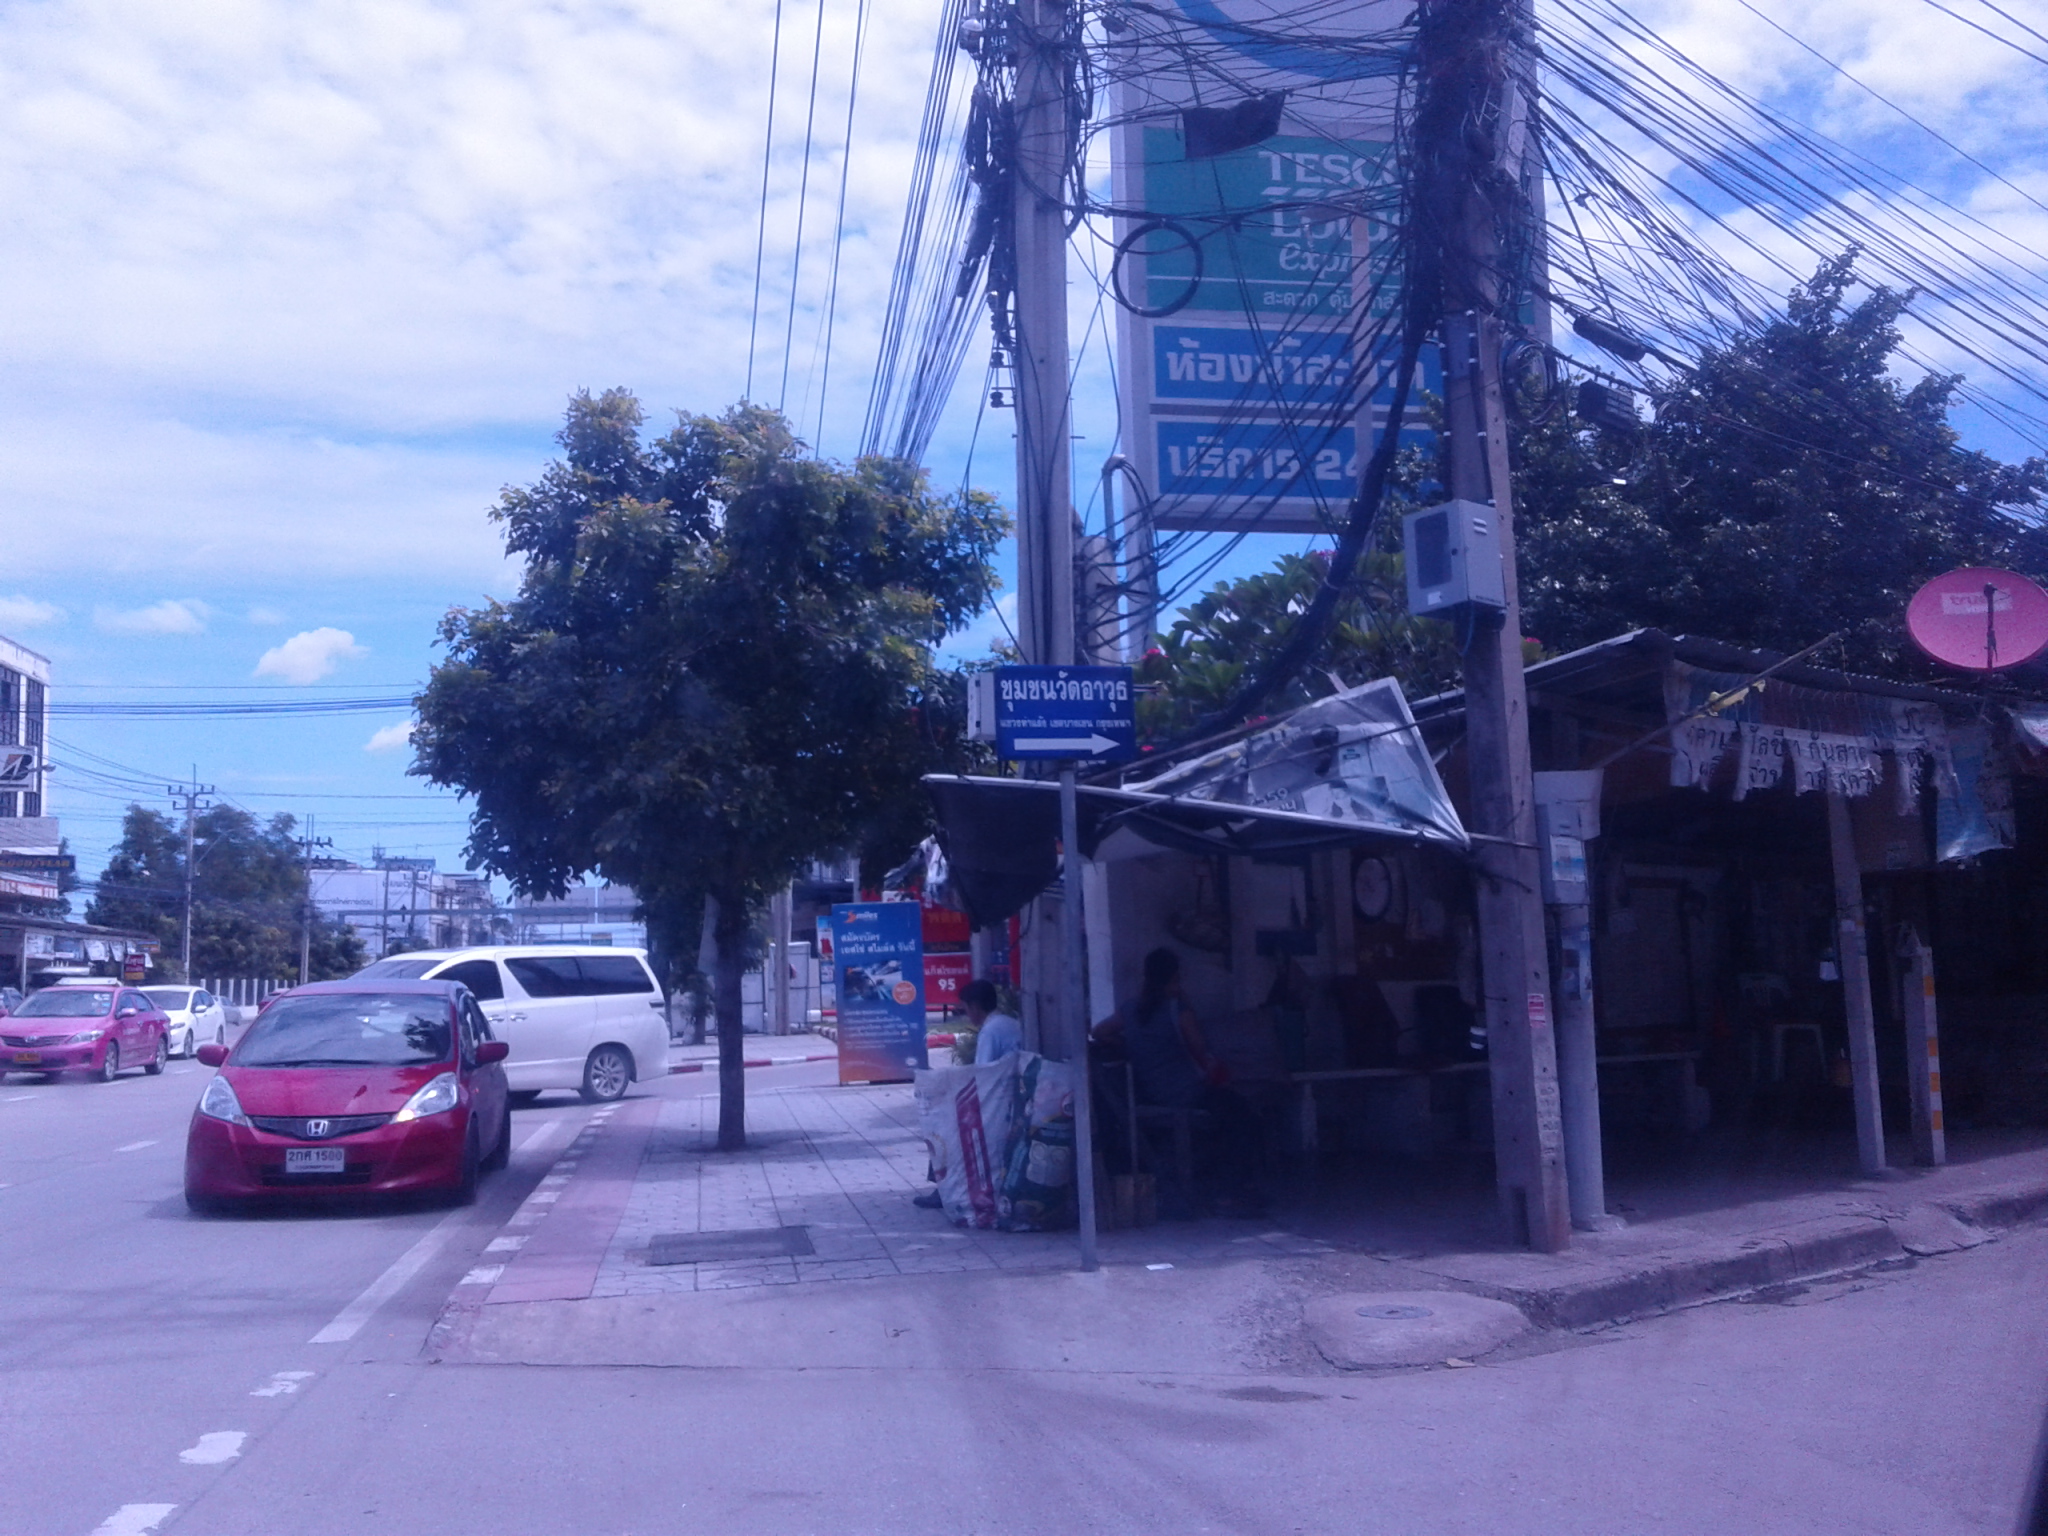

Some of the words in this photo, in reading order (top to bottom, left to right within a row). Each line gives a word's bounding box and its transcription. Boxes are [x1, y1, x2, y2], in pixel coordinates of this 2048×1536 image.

[1279, 242, 1406, 279] exprss
[1166, 336, 1424, 390] ห้องน้ำสะา
[1000, 670, 1128, 713] ชุมชนวัดอาวุธ
[938, 979, 956, 990] 95
